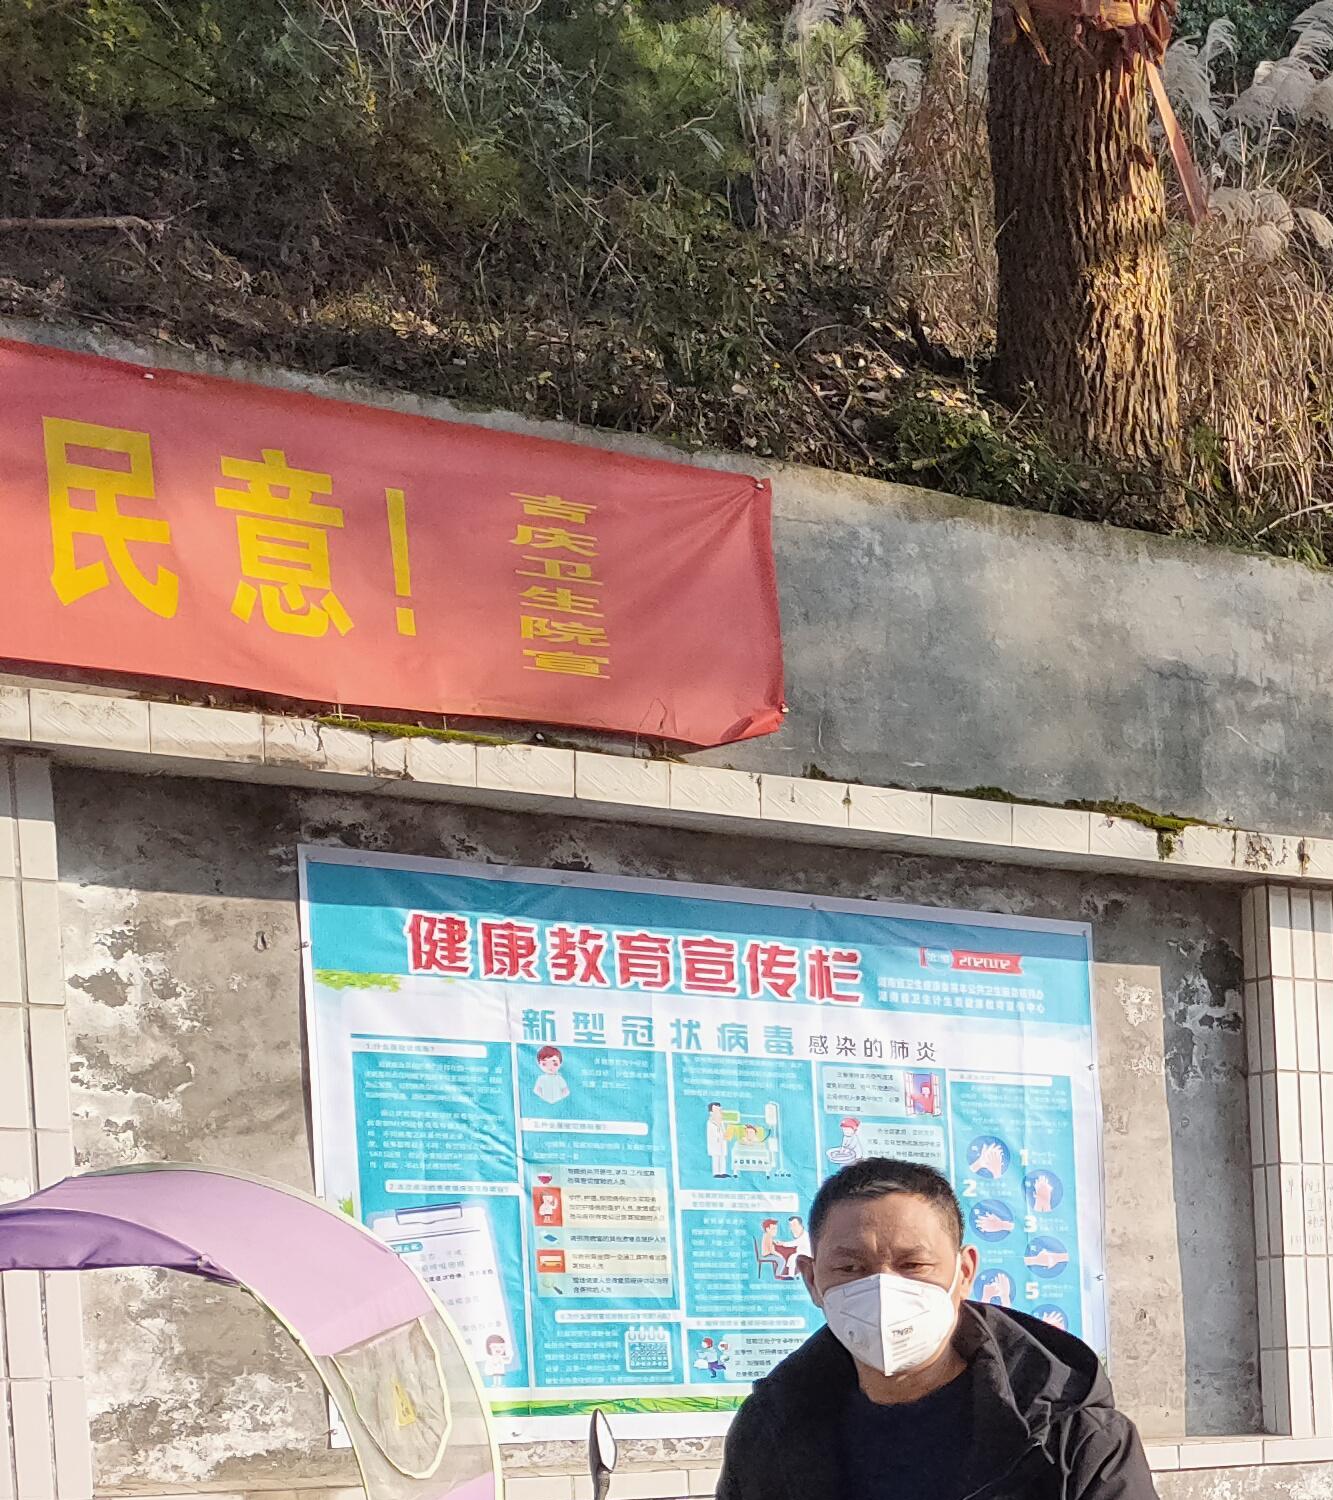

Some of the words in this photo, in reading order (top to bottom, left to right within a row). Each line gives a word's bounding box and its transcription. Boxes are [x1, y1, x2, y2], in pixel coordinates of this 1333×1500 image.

[42, 416, 417, 638] 民意！
[510, 491, 611, 680] 吉庆卫生院宣
[406, 913, 861, 1003] 健康教育宣传栏
[522, 1007, 794, 1056] 新型冠状病毒
[808, 1034, 936, 1063] 感染的肺炎
[962, 1179, 977, 1197] 2
[1024, 1215, 1037, 1233] 3
[1025, 1282, 1040, 1300] 5
